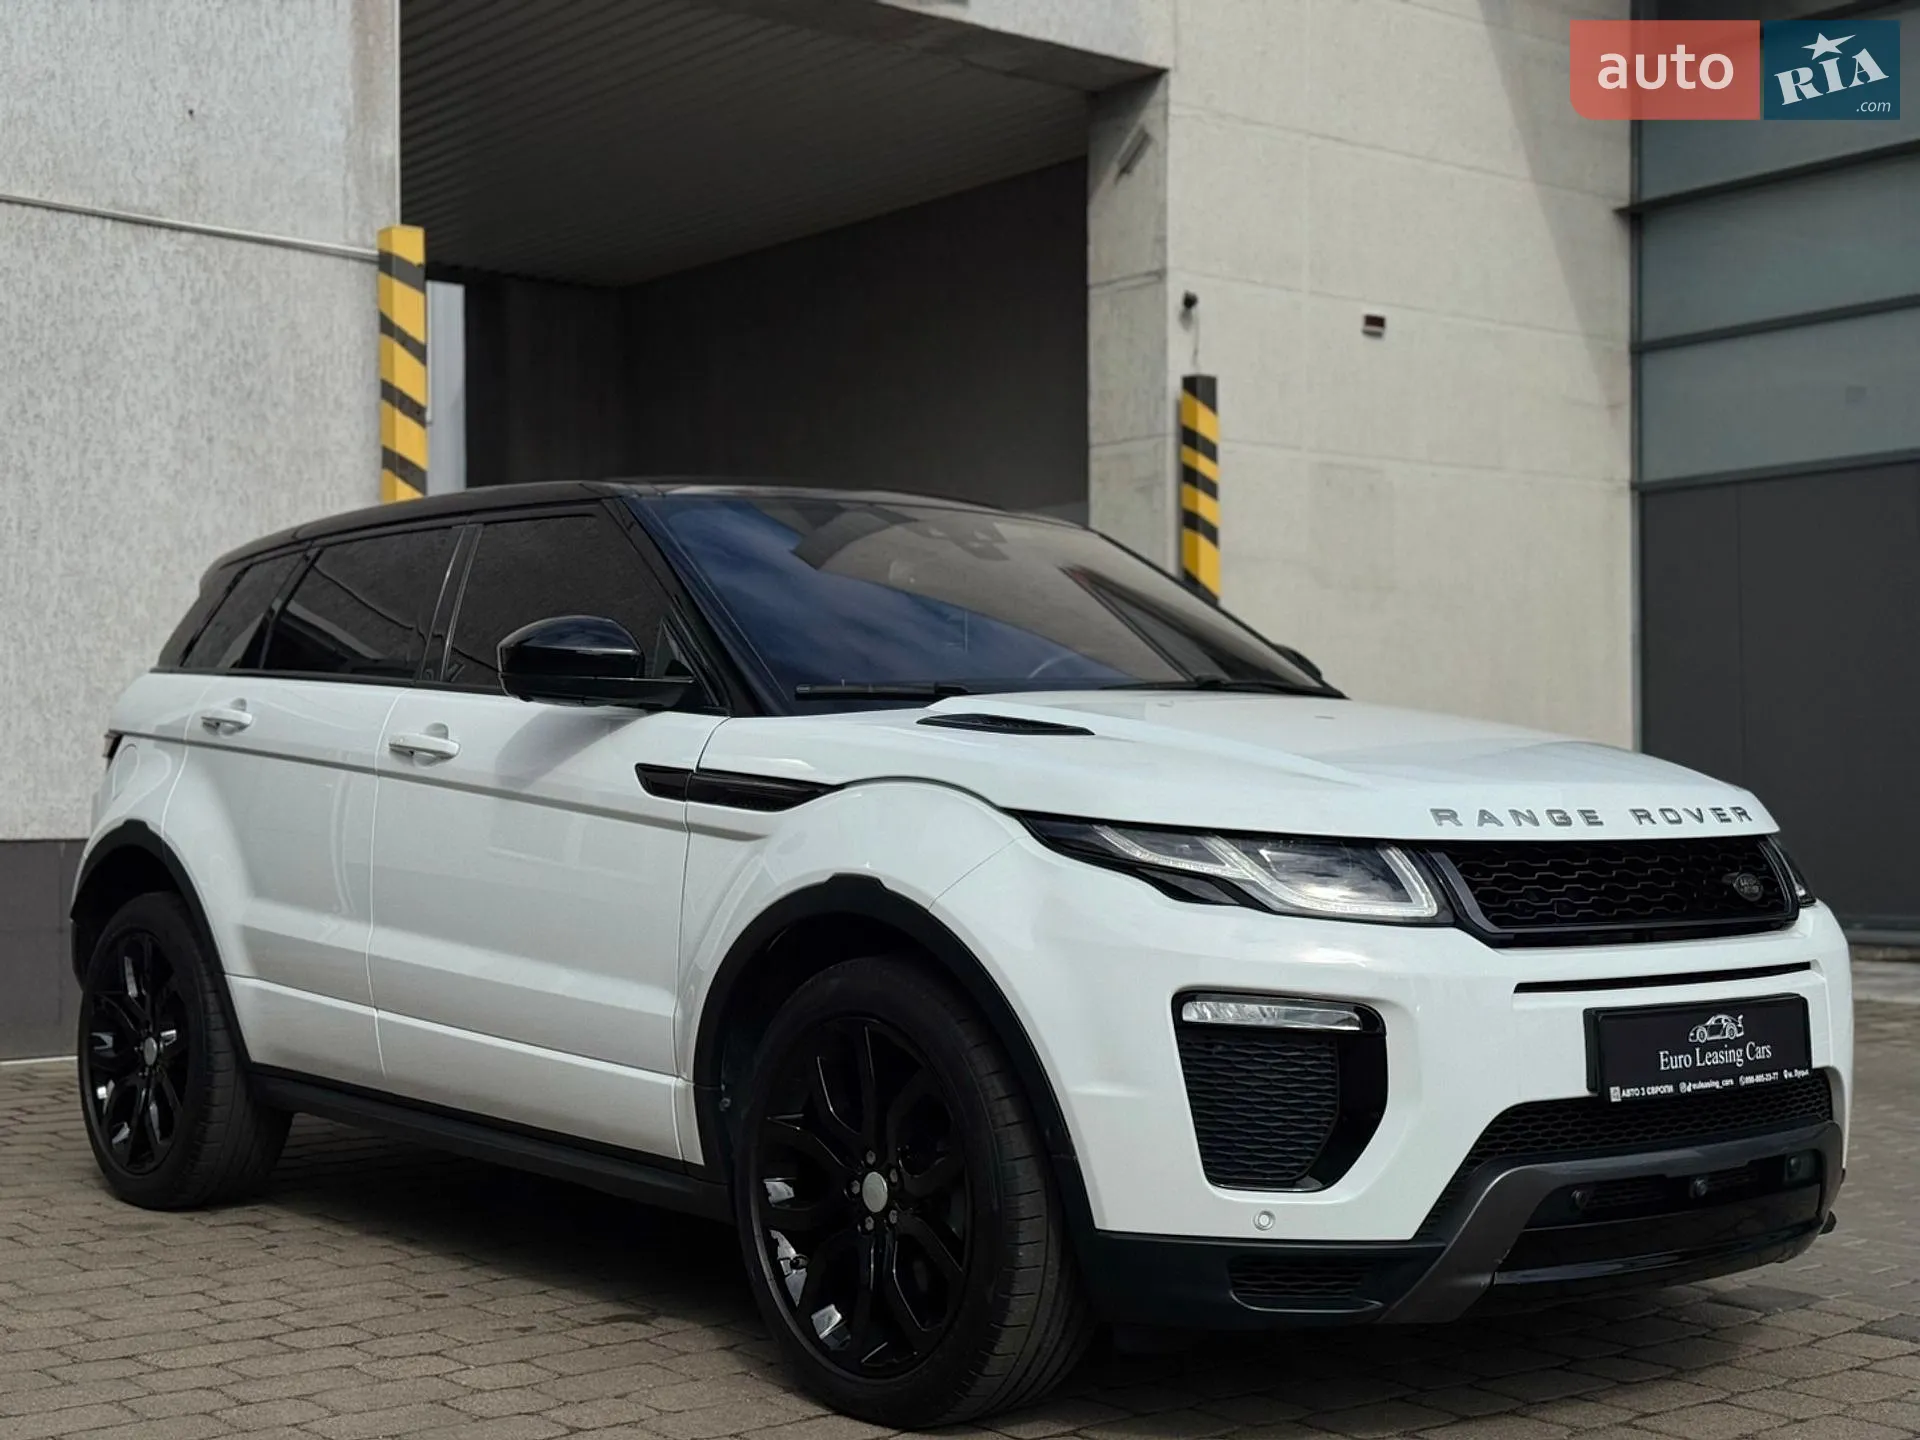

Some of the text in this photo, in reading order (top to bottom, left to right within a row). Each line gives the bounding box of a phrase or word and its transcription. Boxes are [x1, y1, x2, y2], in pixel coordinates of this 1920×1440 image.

[1430, 806, 1753, 827] RANGE ROVER
[1659, 1041, 1772, 1071] Euro Leasing Cars
